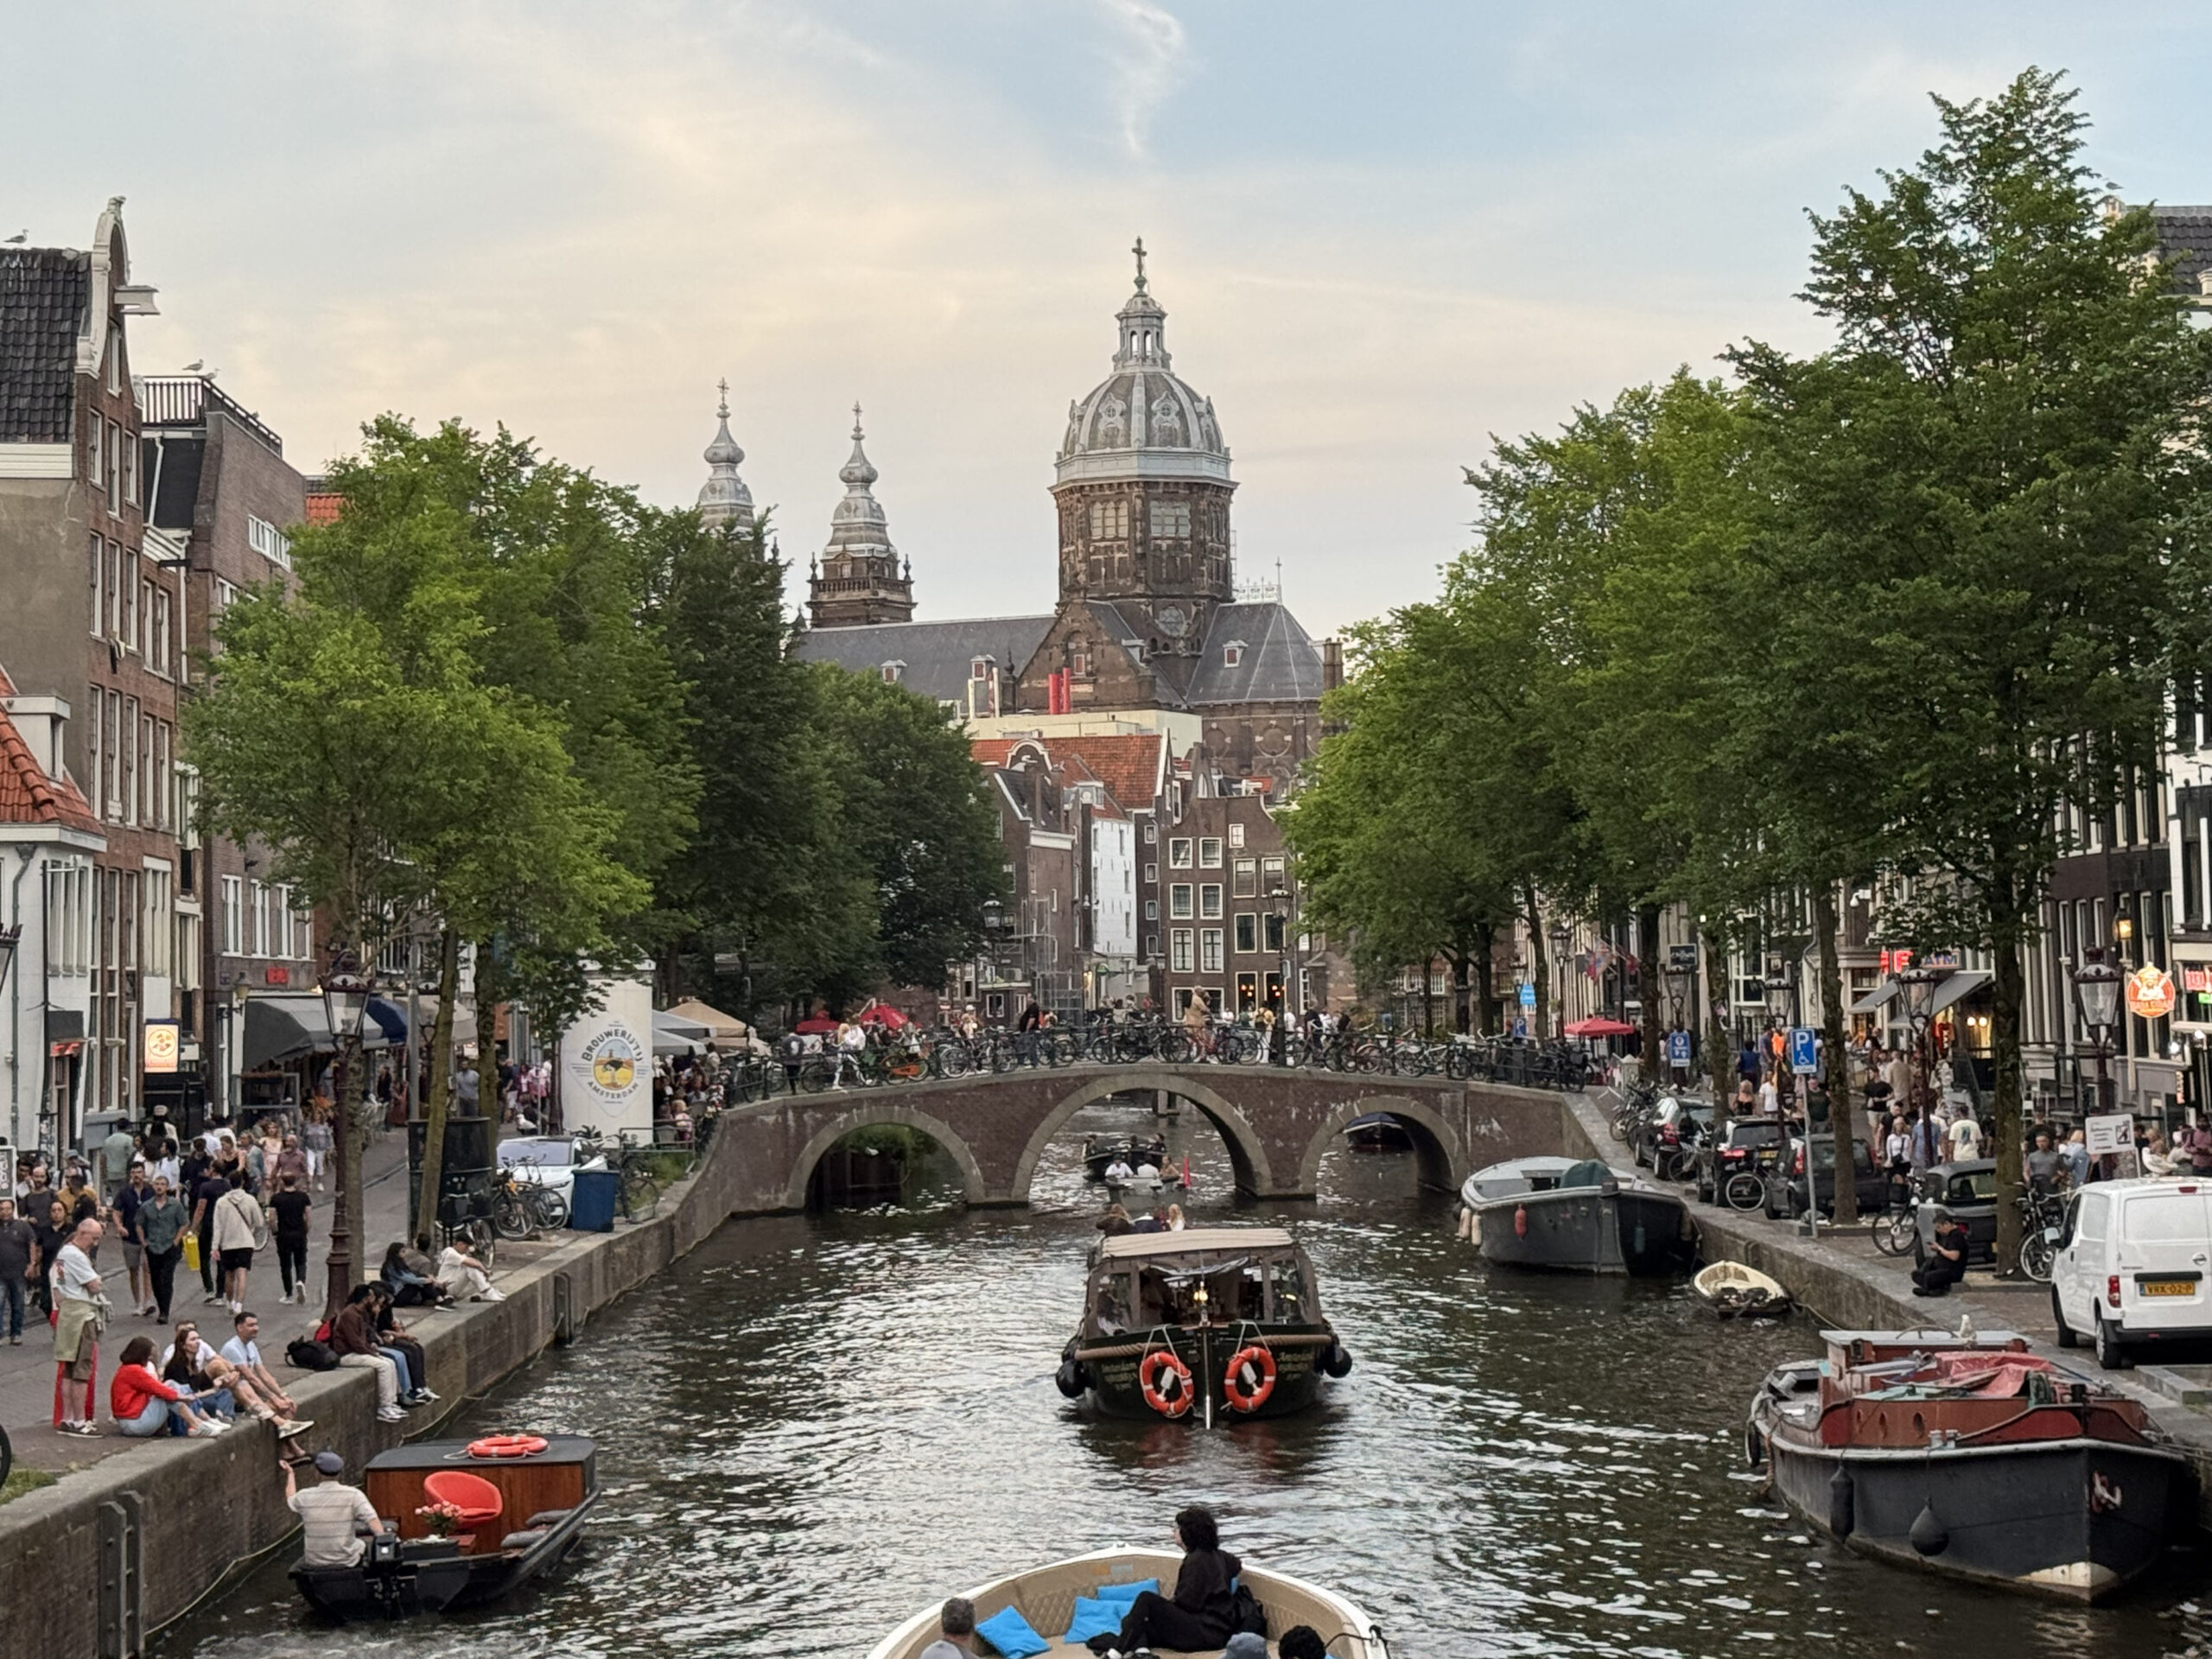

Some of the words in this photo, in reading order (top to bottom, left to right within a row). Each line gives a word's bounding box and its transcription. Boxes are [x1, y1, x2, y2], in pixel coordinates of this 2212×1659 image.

[1924, 953, 1957, 965] ATM
[1796, 1032, 1809, 1051] P
[588, 1081, 639, 1099] AMSTERDAM
